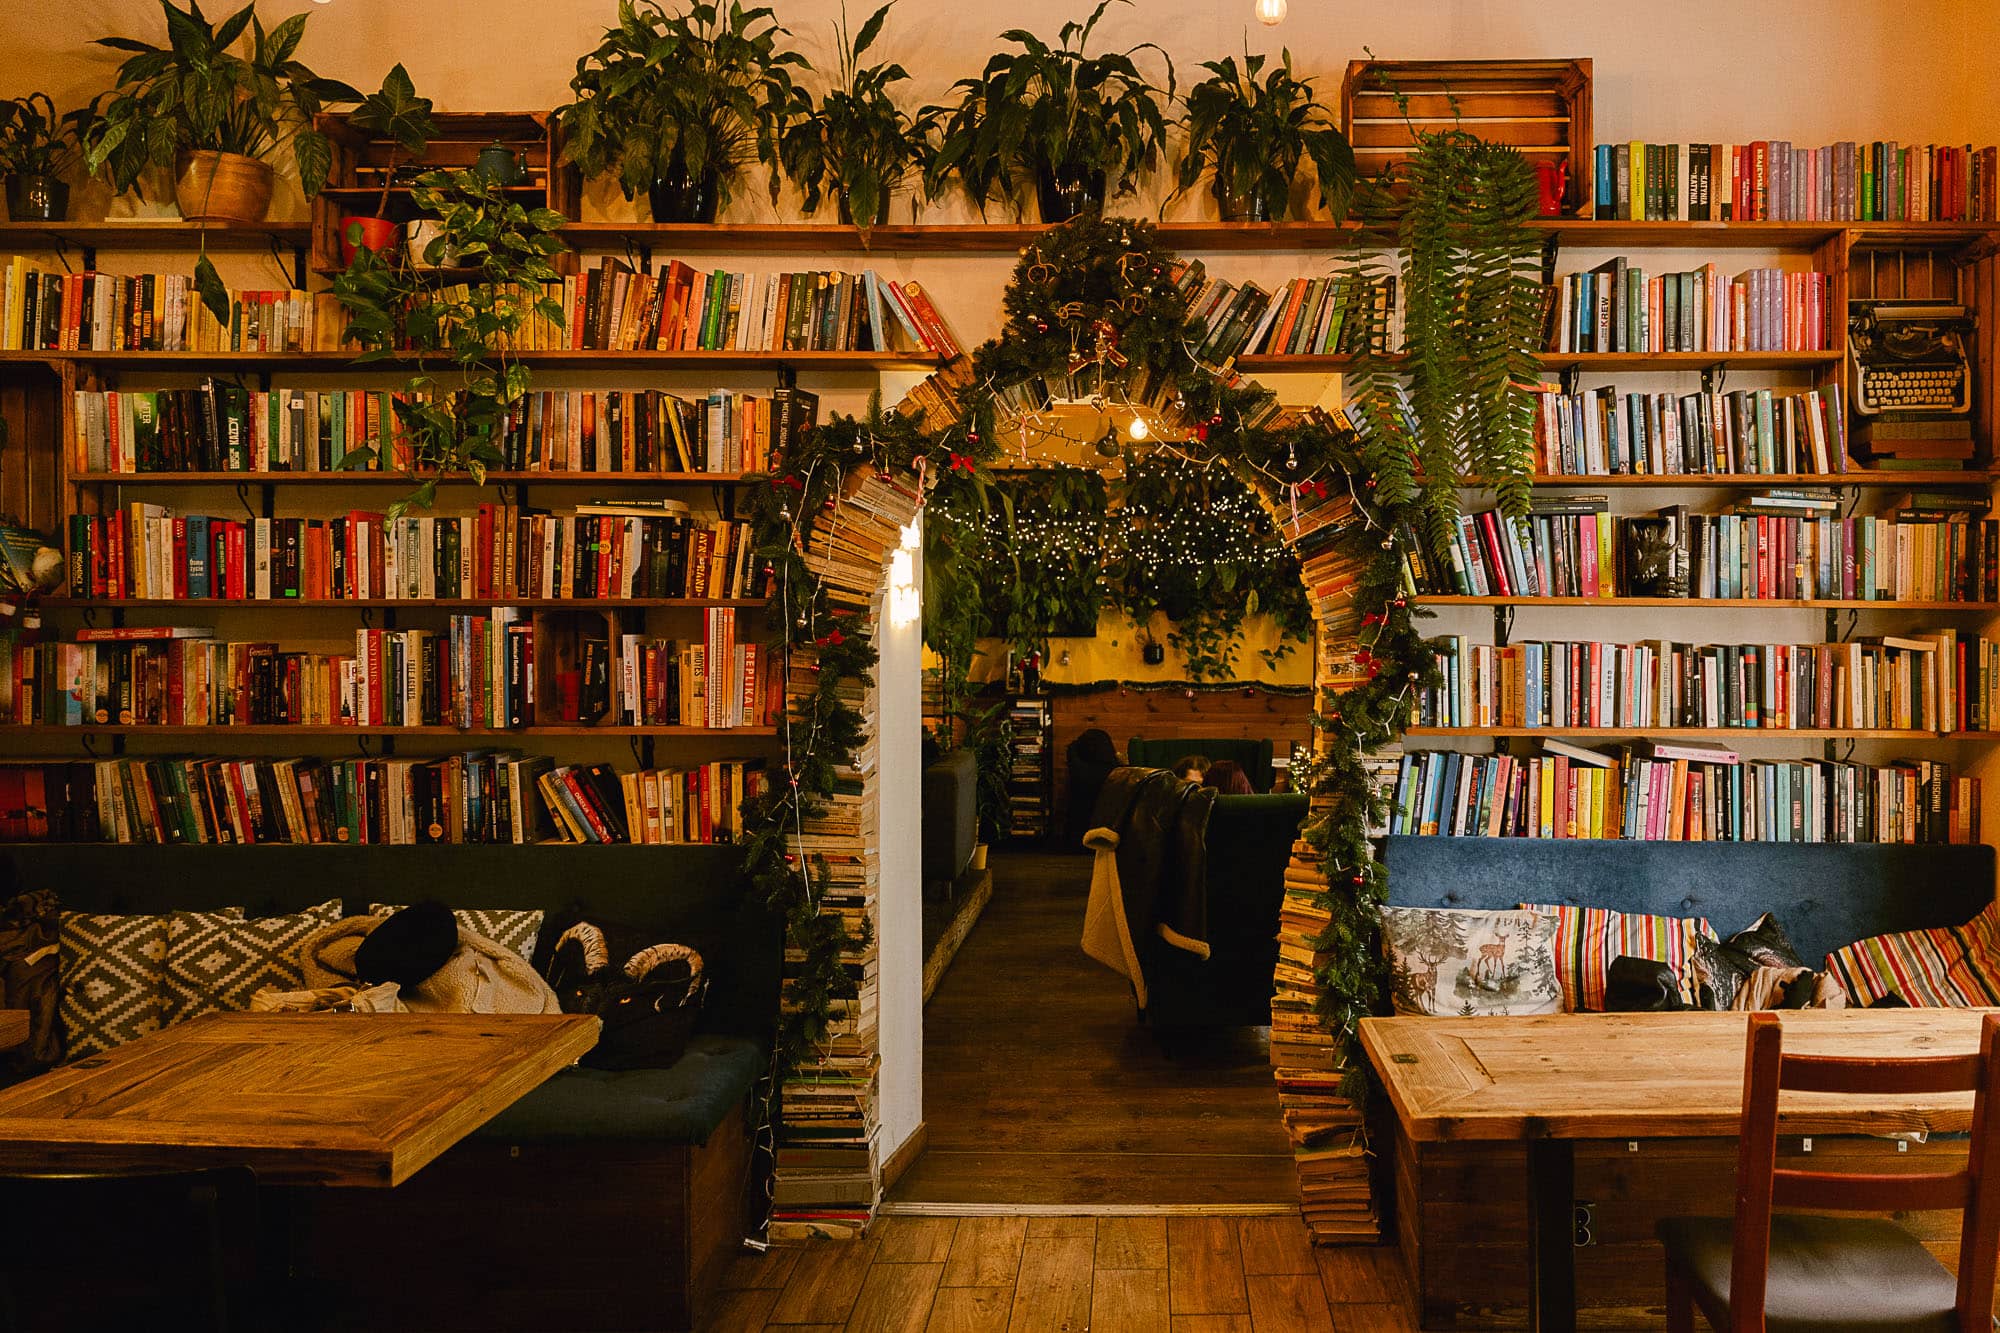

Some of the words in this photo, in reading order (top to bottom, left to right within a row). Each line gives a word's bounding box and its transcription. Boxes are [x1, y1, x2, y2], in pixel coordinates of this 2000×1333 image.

[1690, 173, 1698, 205] KATYNIA
[1700, 175, 1708, 206] KATYNIA
[1600, 297, 1609, 327] KREW
[780, 402, 790, 425] MICHAEL
[778, 425, 788, 447] JORDAN
[257, 524, 267, 550] MOYES
[462, 559, 470, 581] FARMA
[369, 635, 377, 656] END
[473, 633, 482, 658] Atlas
[369, 658, 377, 686] TIMES
[407, 659, 416, 674] FREE
[423, 643, 433, 682] Troubled
[694, 650, 703, 676] MOYES
[407, 676, 416, 700] AGENTS
[473, 659, 482, 701] Obscura
[745, 651, 755, 705] REPLIKA
